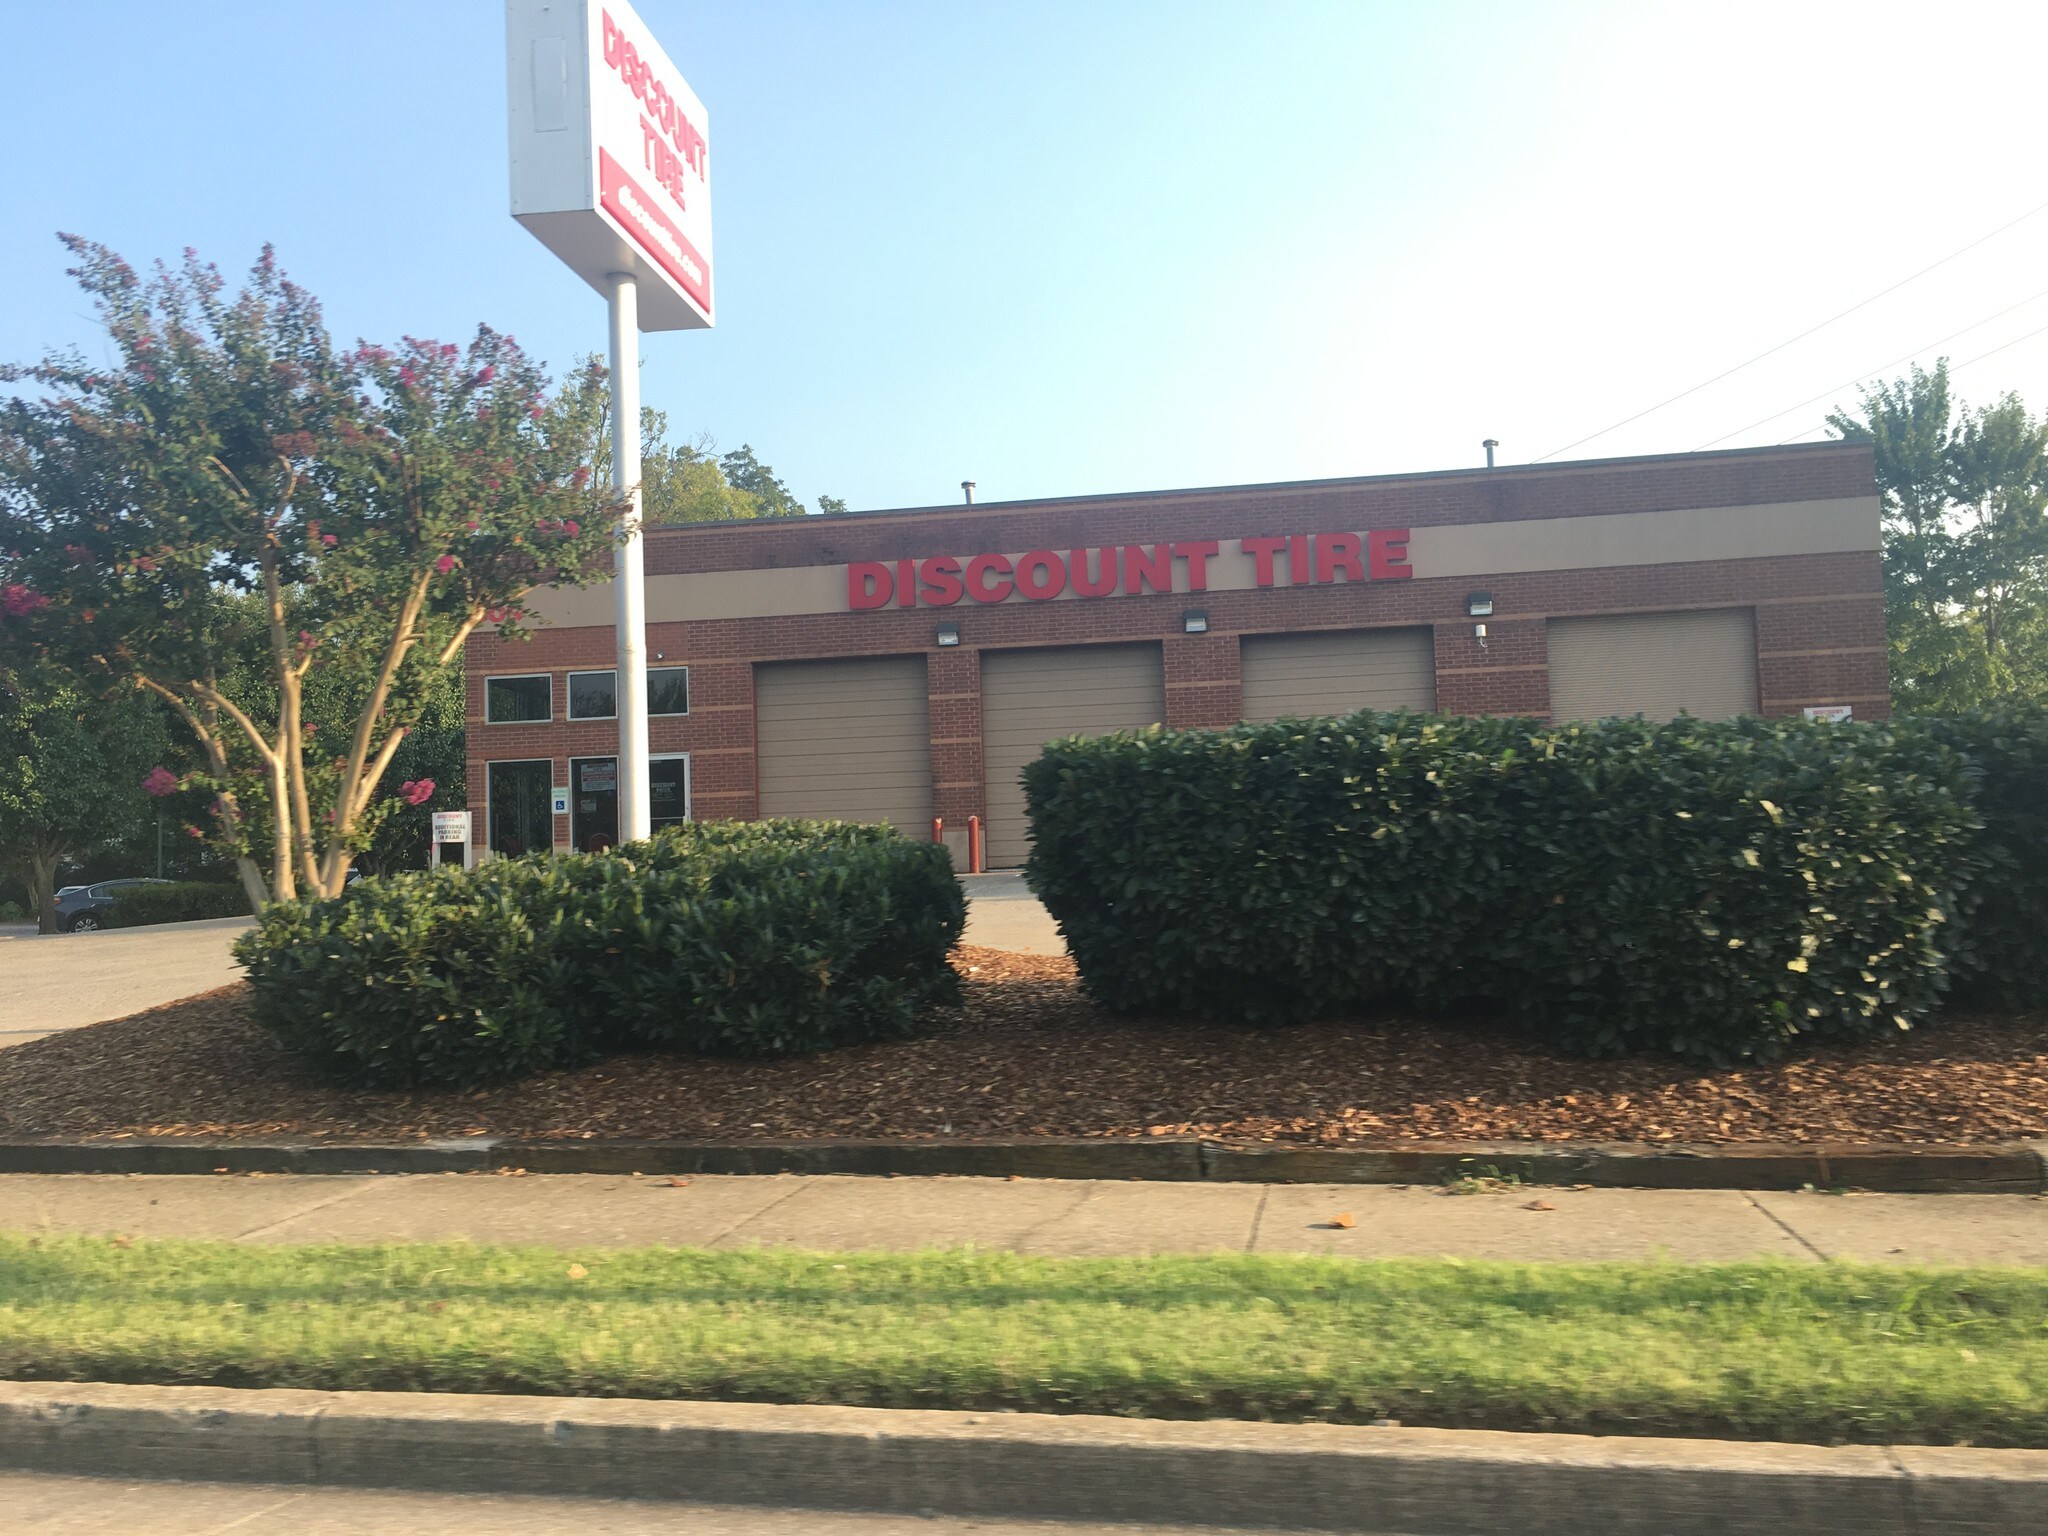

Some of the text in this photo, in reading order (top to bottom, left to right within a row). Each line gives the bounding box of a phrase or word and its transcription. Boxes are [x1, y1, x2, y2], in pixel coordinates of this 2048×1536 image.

[603, 7, 706, 183] DISCOUNT
[640, 112, 685, 212] TIRE
[848, 528, 1412, 610] DISCOUNT TIRE
